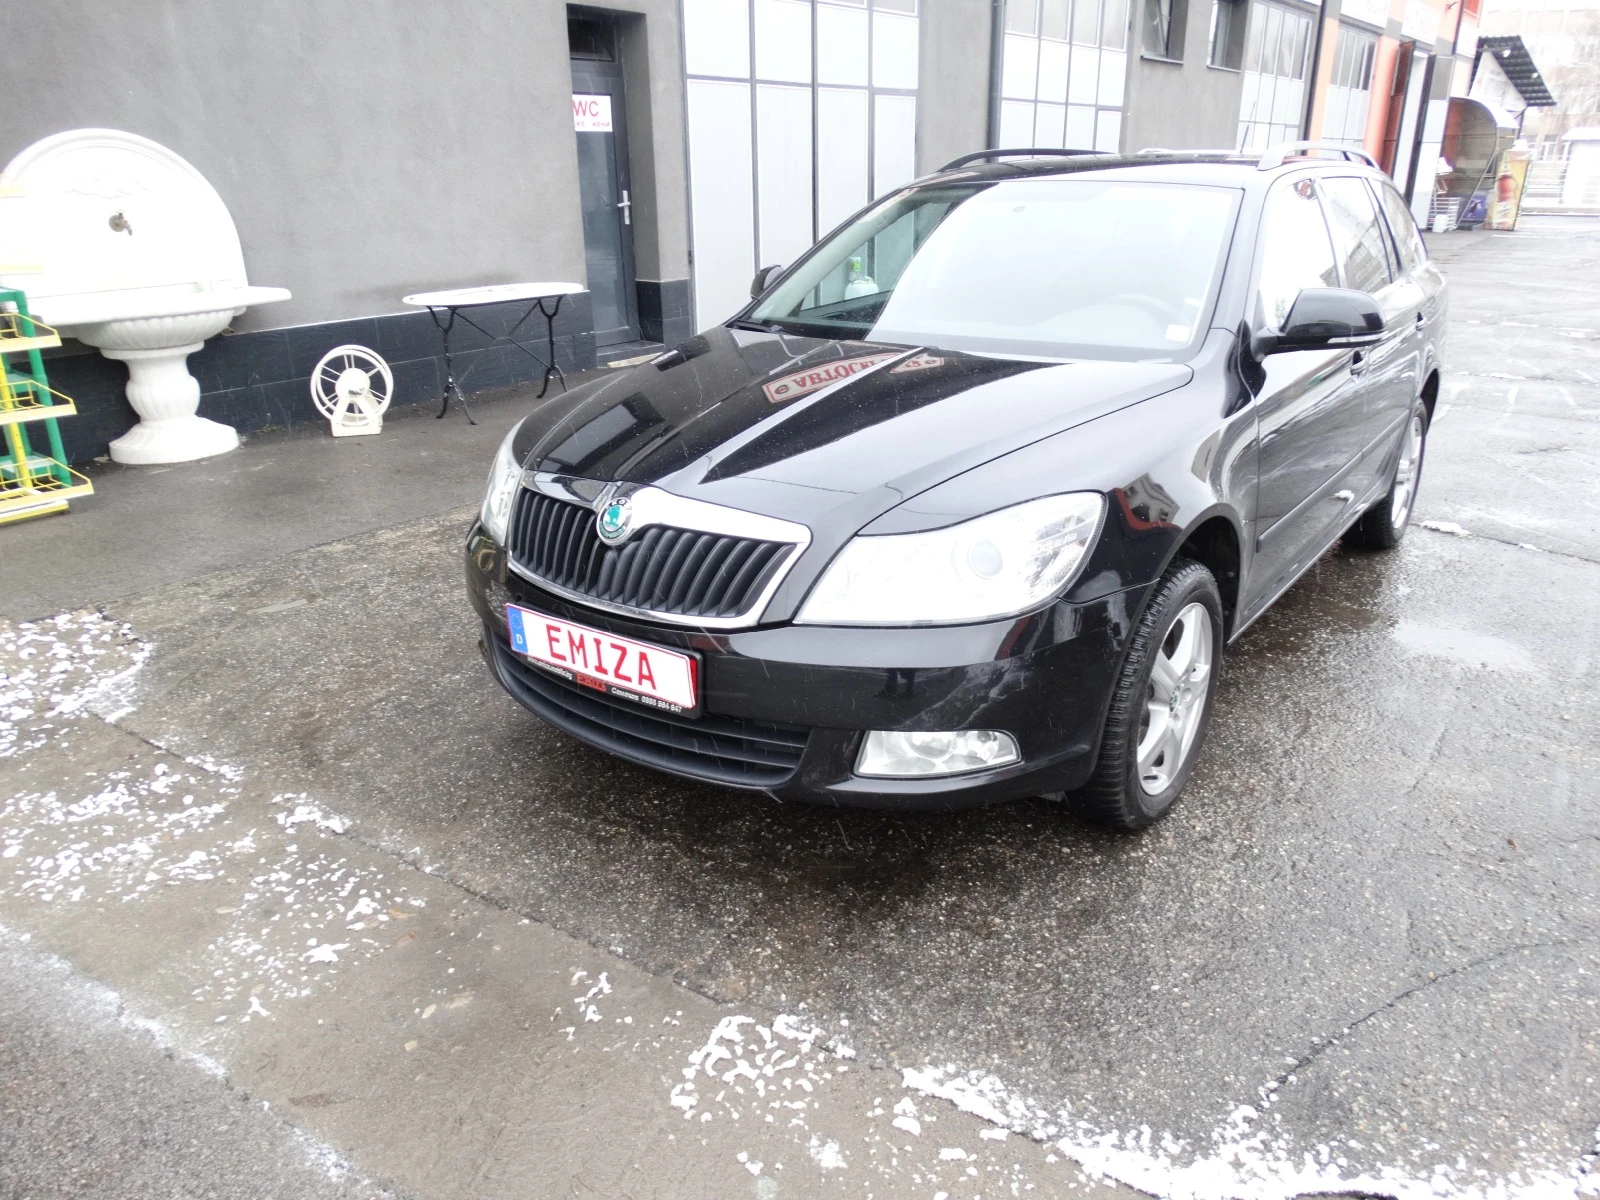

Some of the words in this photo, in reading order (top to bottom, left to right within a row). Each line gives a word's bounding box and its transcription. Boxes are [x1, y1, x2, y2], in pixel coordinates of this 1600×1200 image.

[572, 100, 599, 117] WC
[516, 634, 524, 644] D
[546, 623, 657, 690] EMIZA
